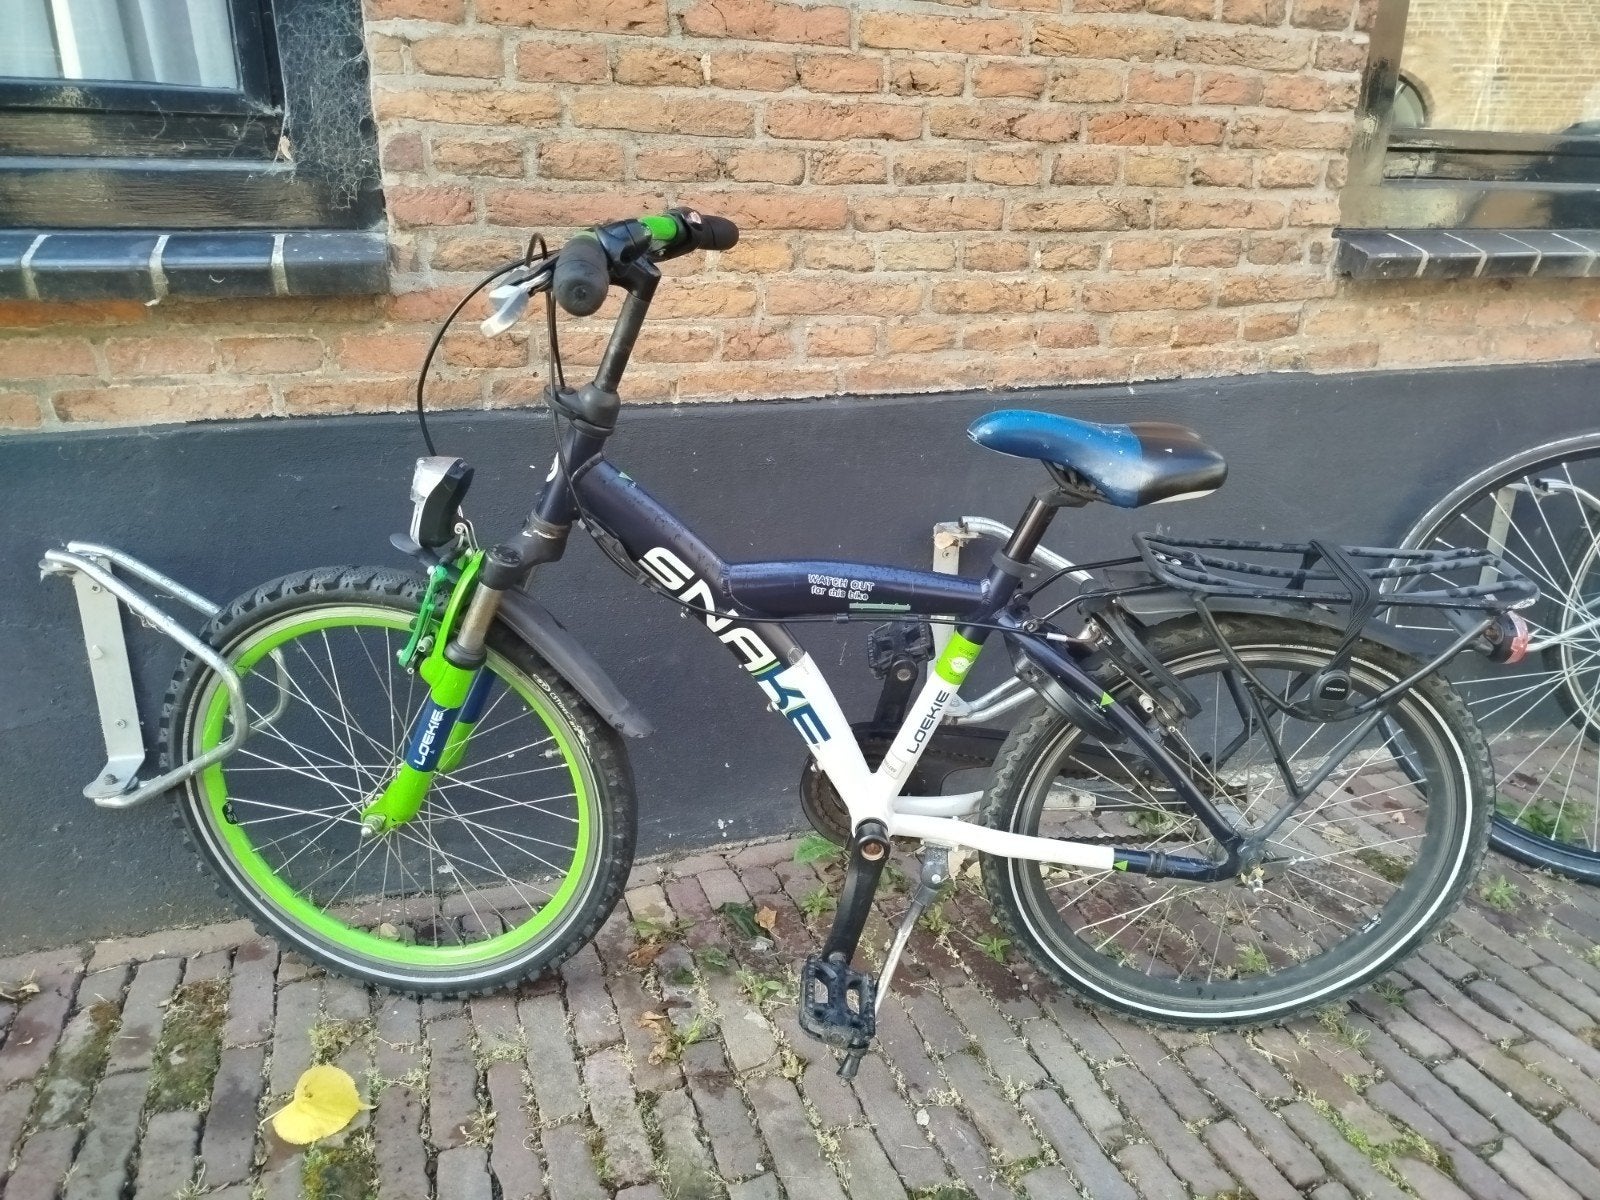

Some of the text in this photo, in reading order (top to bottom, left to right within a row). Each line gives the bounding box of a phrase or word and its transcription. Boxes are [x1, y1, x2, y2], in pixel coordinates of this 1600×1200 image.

[808, 574, 875, 591] WATCH OUT
[810, 585, 869, 601] for this bike
[638, 547, 831, 745] SNAKE
[414, 709, 444, 766] LOEKIE
[907, 690, 950, 754] LOEKIE
